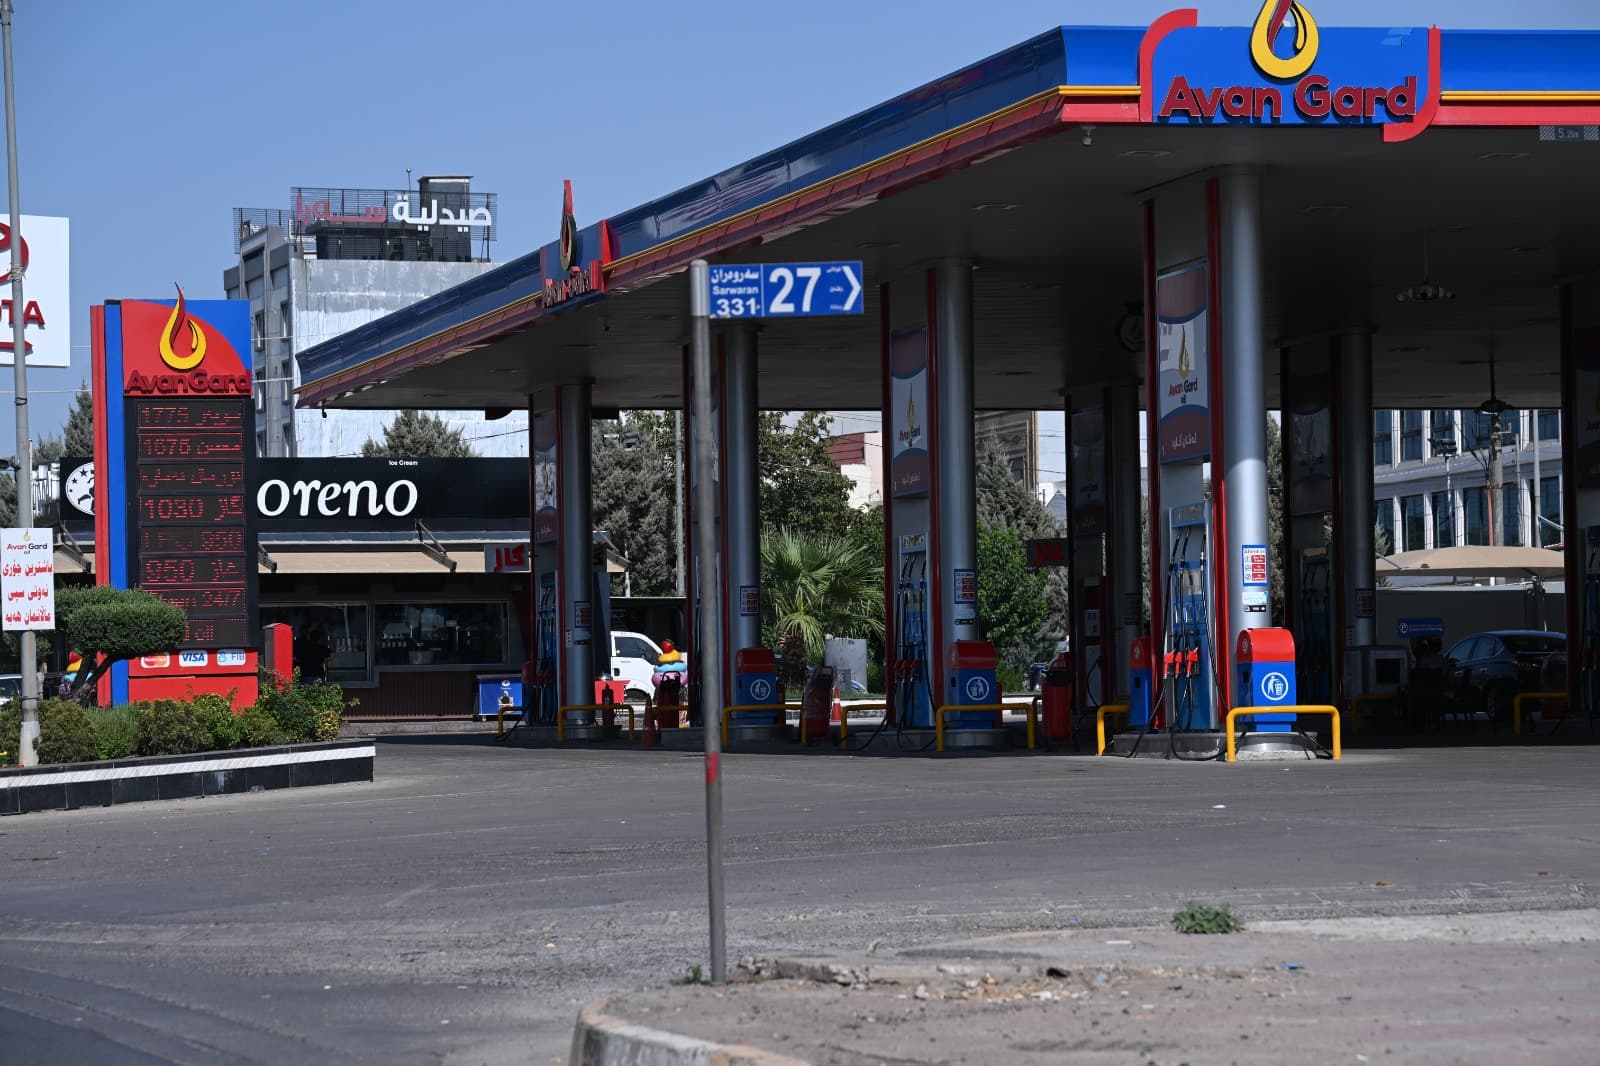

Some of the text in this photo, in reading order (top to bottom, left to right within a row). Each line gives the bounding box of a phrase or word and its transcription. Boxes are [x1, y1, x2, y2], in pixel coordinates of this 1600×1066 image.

[1159, 75, 1417, 117] Avan Gard
[392, 194, 492, 233] صيدلية
[712, 285, 759, 295] Sarwaran
[769, 267, 821, 313] 27
[0, 299, 45, 326] TA
[716, 298, 757, 315] 331
[256, 479, 418, 517] oreno
[145, 499, 204, 519] 1030
[28, 542, 47, 550] Gard
[145, 560, 195, 582] 950
[202, 590, 240, 607] 24/7
[181, 652, 205, 662] VISA
